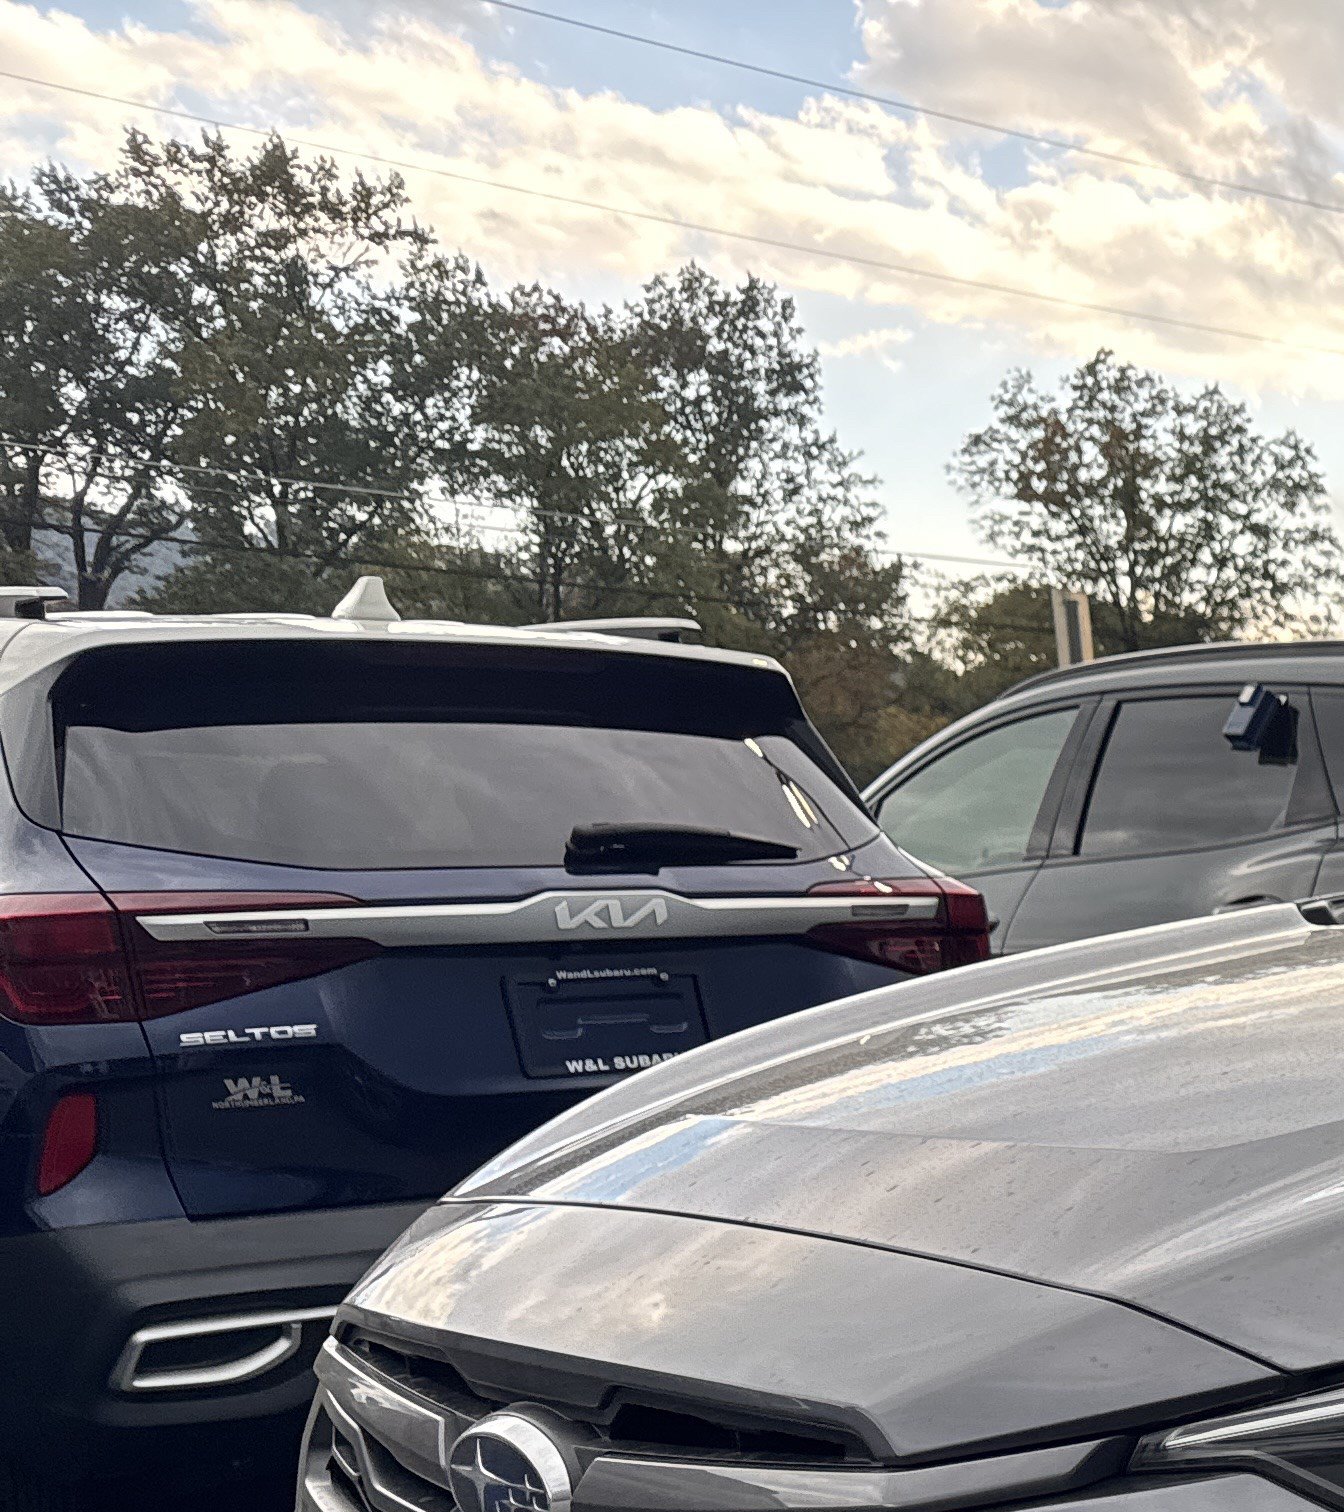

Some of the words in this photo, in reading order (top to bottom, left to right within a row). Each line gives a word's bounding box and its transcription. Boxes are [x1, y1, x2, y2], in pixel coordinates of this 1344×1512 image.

[555, 899, 668, 929] KIA
[556, 967, 658, 980] WandLsubaru.com
[179, 1024, 318, 1047] SELTOS
[565, 1058, 610, 1074] W&L
[613, 1051, 680, 1070] SUBA
[223, 1074, 293, 1101] W&L
